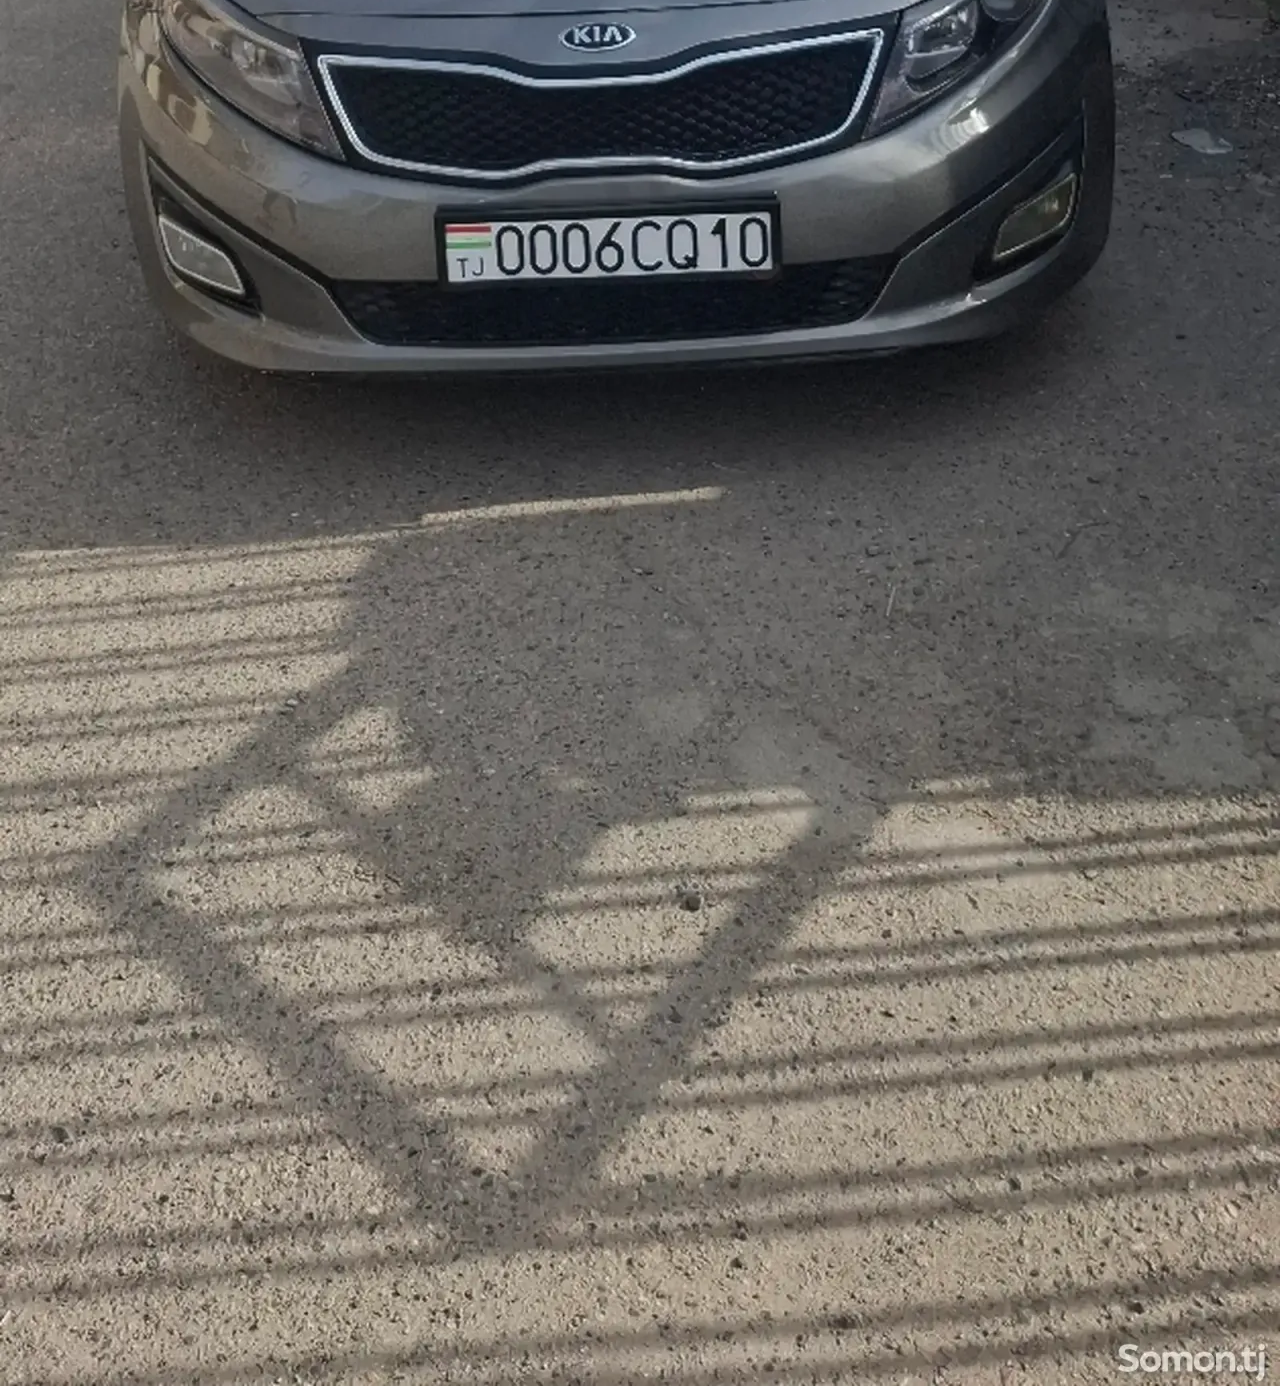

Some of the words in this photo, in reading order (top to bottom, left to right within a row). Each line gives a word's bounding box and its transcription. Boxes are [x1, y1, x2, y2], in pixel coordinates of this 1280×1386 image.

[573, 26, 622, 44] KIA
[495, 216, 769, 276] 0006CQ10
[456, 256, 485, 278] TJ
